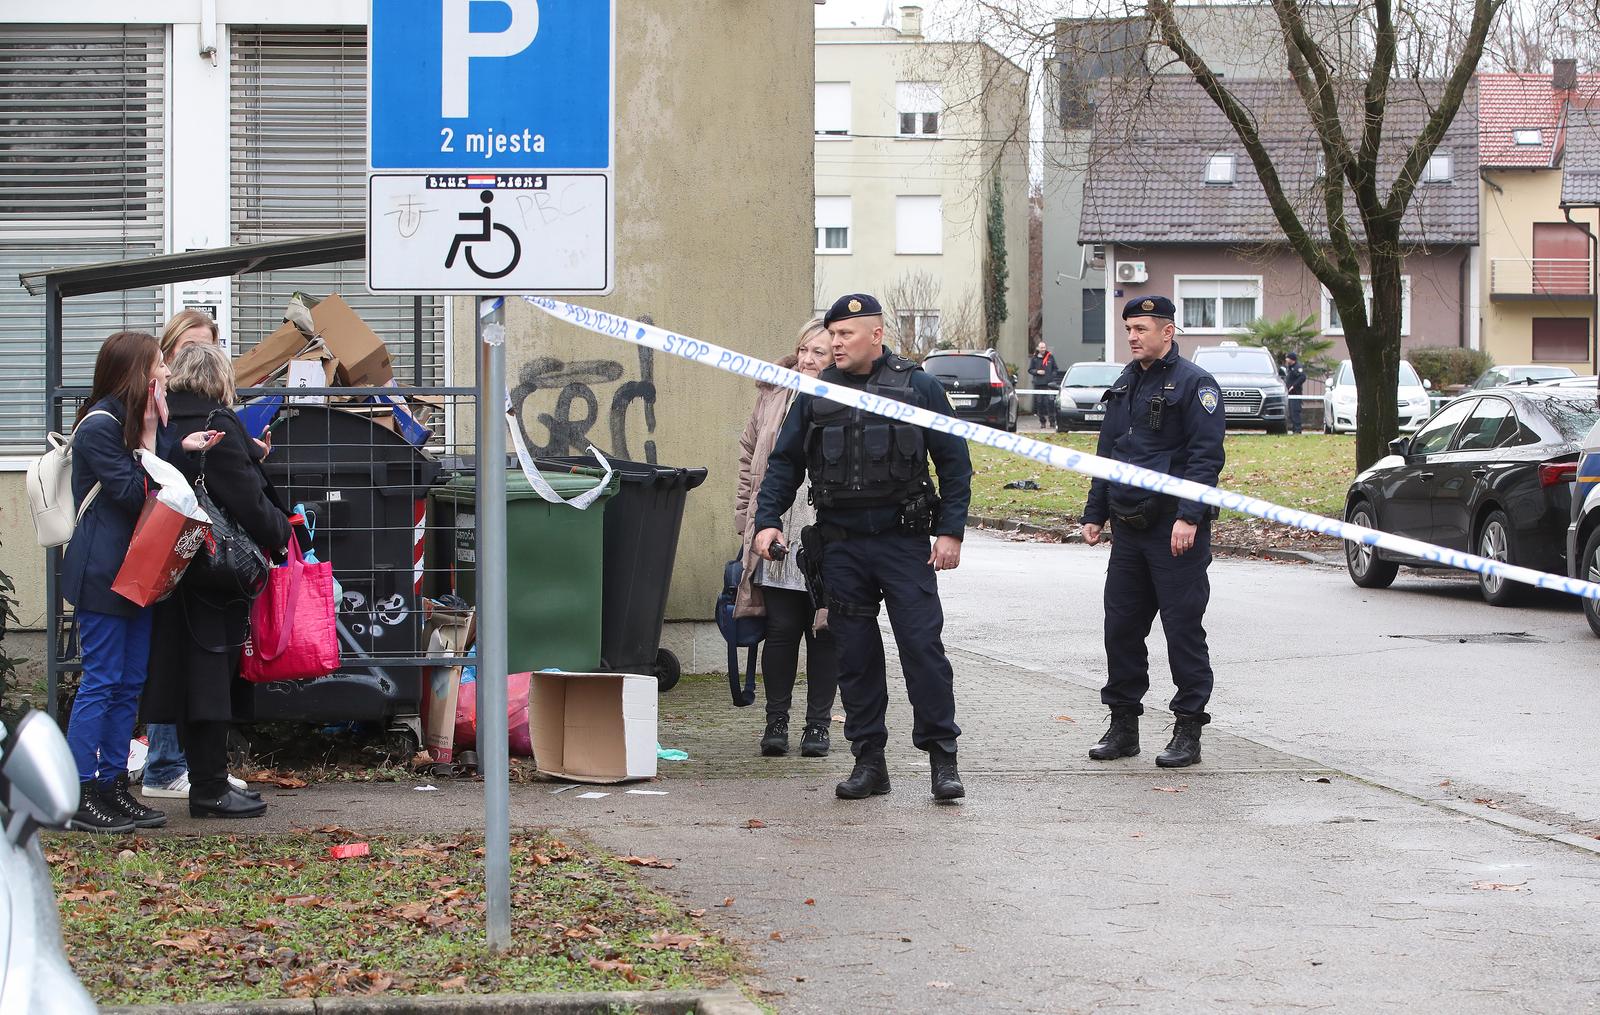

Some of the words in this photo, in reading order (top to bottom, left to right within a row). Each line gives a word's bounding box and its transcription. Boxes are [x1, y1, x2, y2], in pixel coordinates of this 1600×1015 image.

[441, 0, 539, 119] P
[440, 127, 454, 153] 2
[466, 128, 545, 159] mjesta
[429, 176, 467, 188] BLUE
[565, 303, 629, 339] POLICIJA
[662, 334, 710, 361] STOP
[717, 351, 801, 390] POLICIJA
[854, 393, 916, 421] STOP
[929, 415, 1053, 464] POLICIJA
[1109, 463, 1184, 493] STOP
